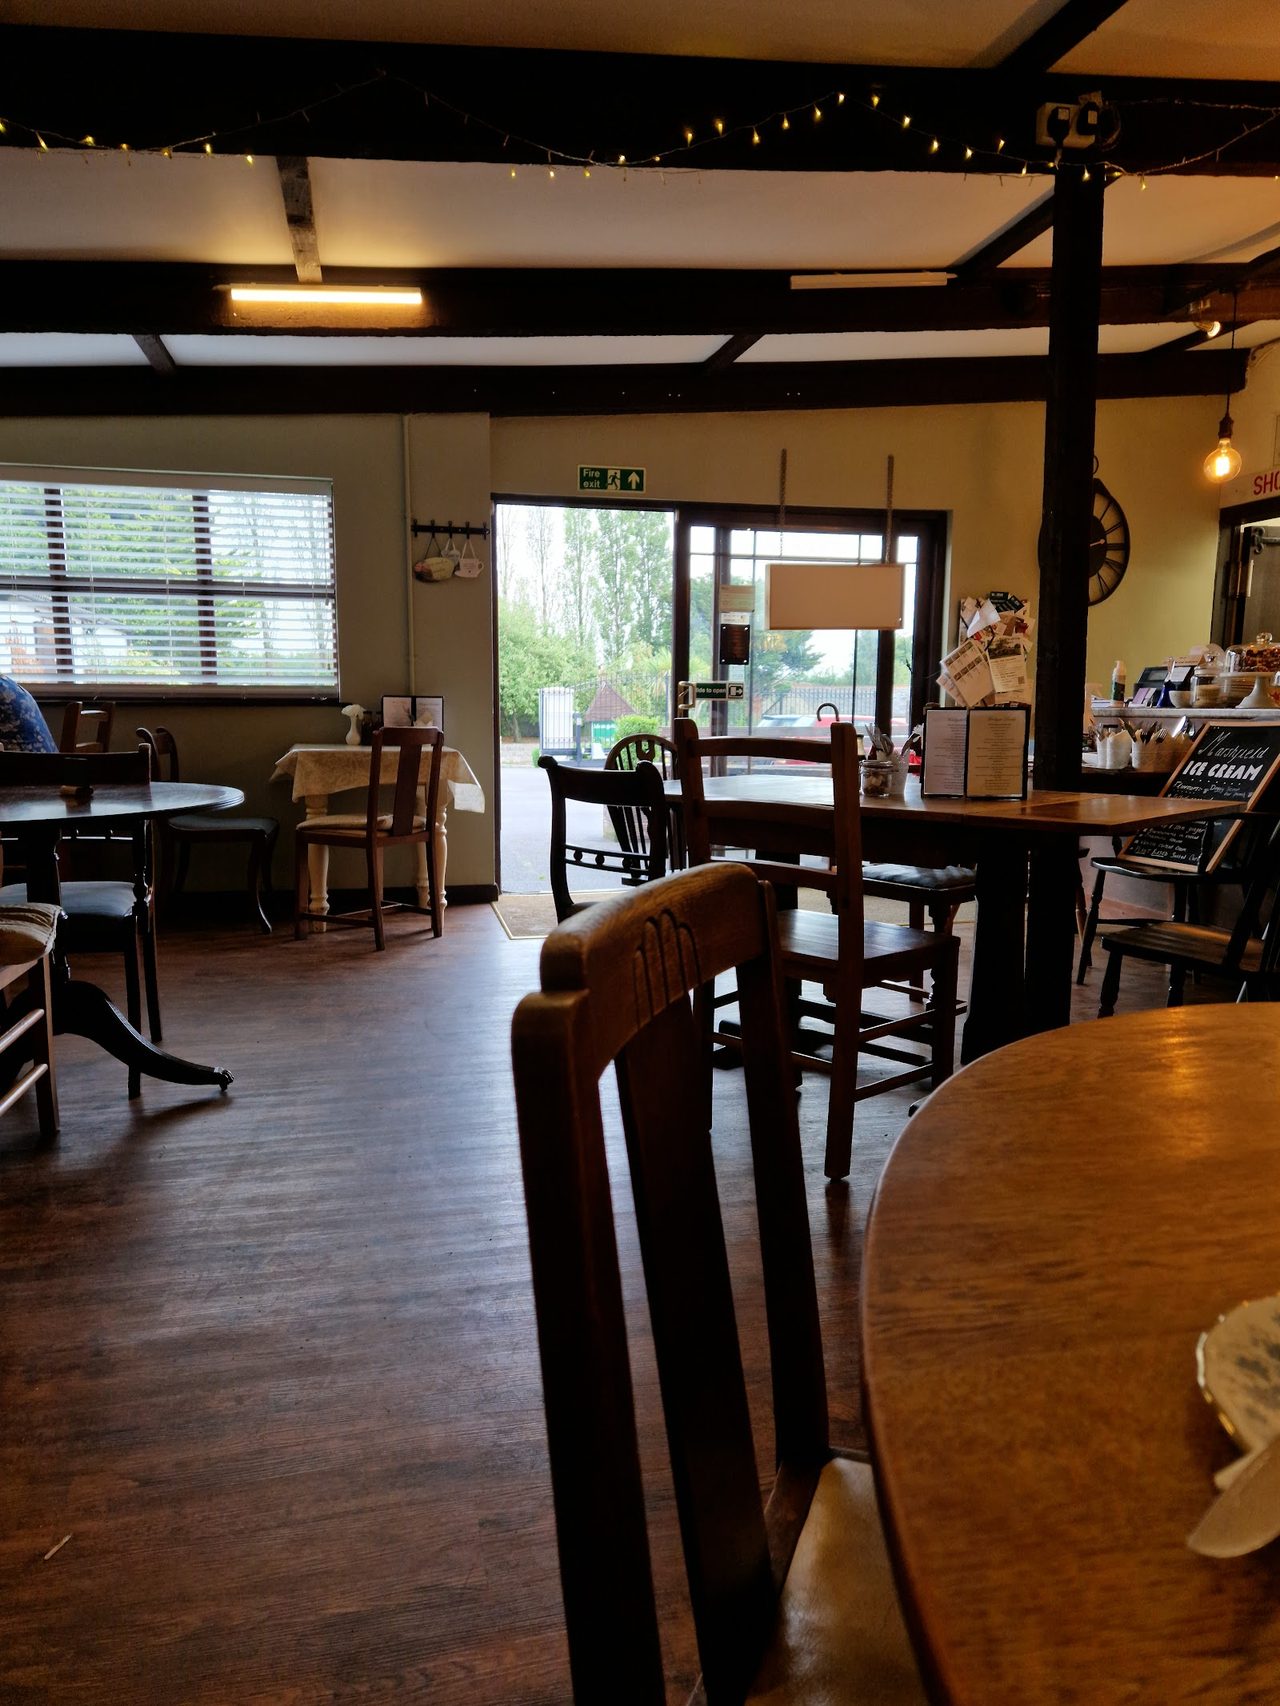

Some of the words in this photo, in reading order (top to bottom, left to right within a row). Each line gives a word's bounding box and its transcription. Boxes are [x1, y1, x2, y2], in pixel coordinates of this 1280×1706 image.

[583, 468, 600, 477] Fire
[583, 480, 600, 488] exit
[1197, 731, 1270, 764] Marshfield
[1182, 760, 1209, 776] ICE
[1207, 763, 1264, 781] CREAM
